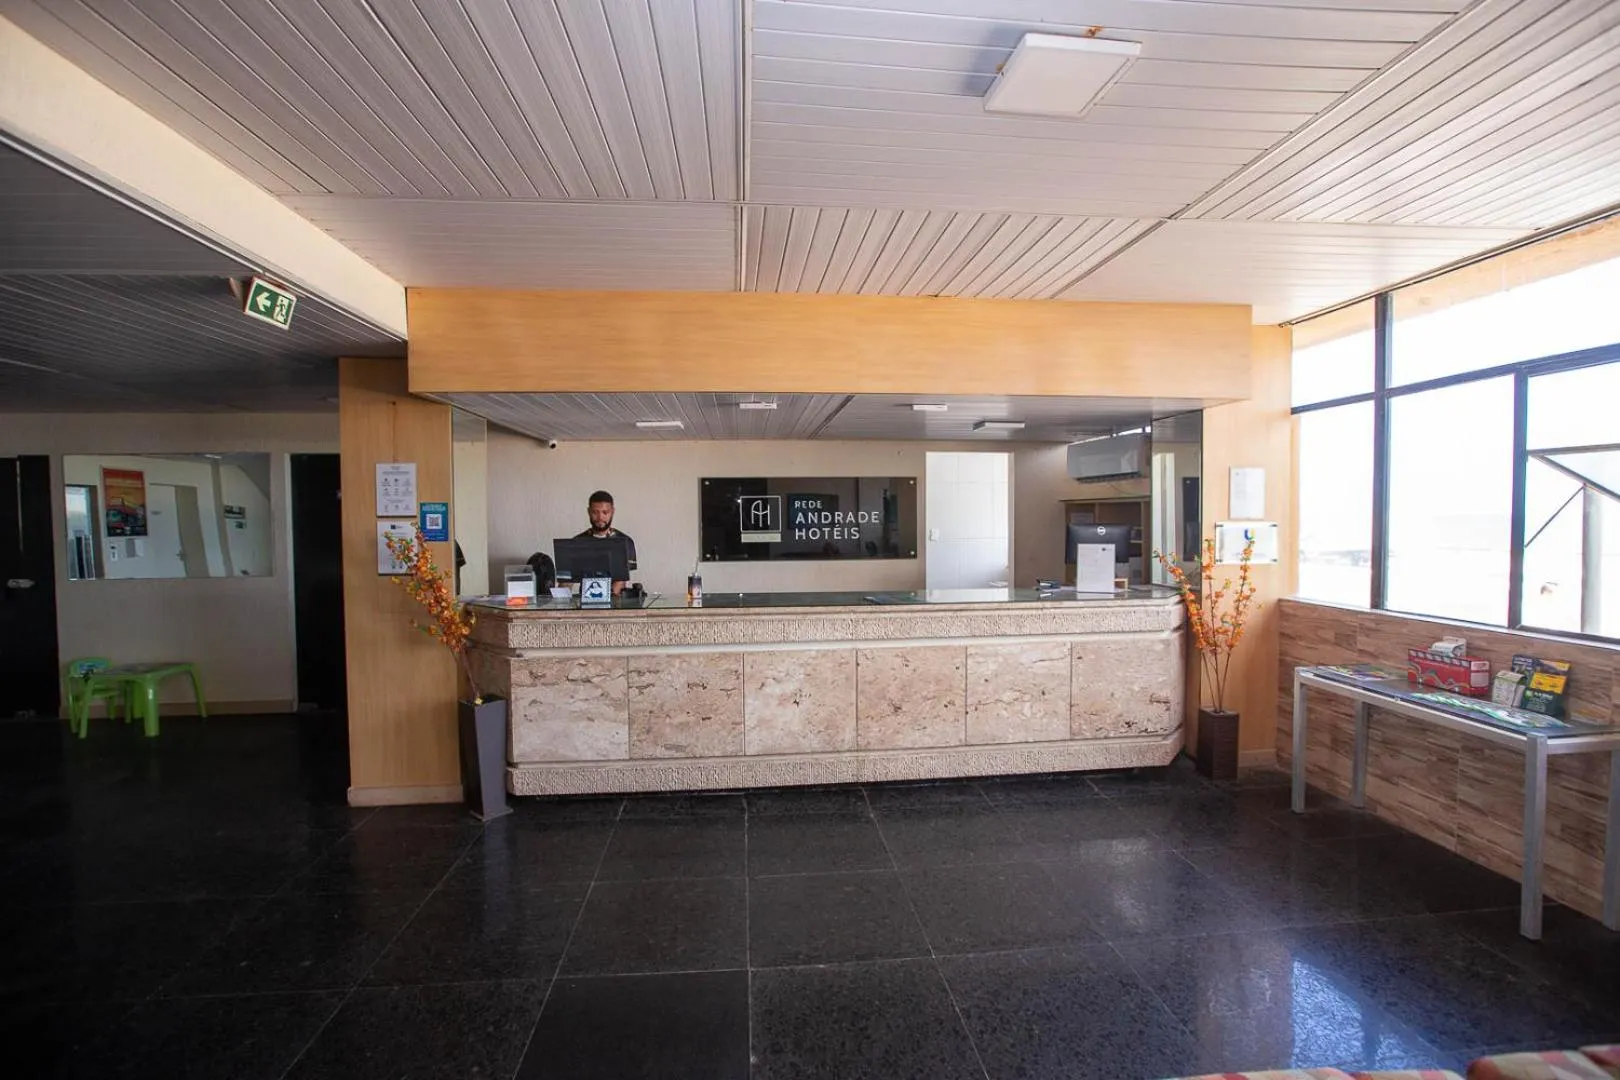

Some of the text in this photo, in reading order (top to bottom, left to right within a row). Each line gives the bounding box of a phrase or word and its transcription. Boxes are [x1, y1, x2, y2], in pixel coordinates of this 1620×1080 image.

[794, 500, 823, 509] REDE
[795, 511, 880, 524] ANDRADE
[795, 524, 860, 540] HOTÉIS
